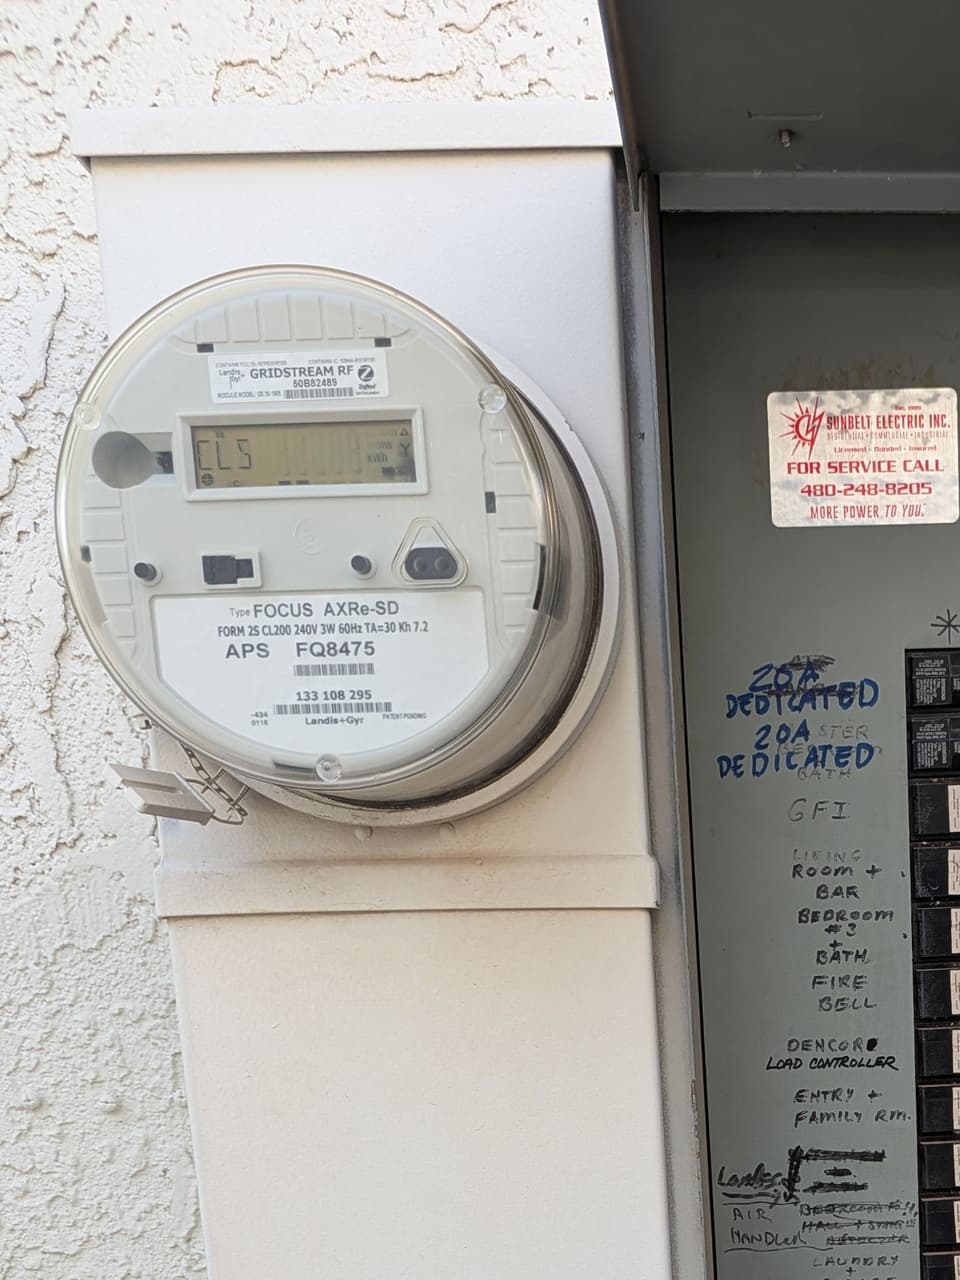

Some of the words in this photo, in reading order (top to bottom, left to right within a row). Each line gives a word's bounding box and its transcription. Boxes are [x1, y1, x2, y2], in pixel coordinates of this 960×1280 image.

[250, 366, 334, 379] GRIDSTREAM
[338, 365, 354, 376] RF
[293, 378, 338, 388] 50B82489
[827, 415, 871, 430] SUNBELT
[877, 414, 925, 429] ELECTRIC
[929, 414, 951, 429] INC.
[787, 462, 820, 474] FOR
[828, 461, 896, 474] SERVICE
[903, 460, 945, 472] CALL
[801, 482, 933, 497] 480-248-8205
[810, 506, 838, 519] MORE
[843, 505, 879, 518] POWER
[885, 505, 897, 517] TO
[230, 608, 250, 617] Type
[253, 603, 313, 618] FOCUS
[324, 601, 399, 616] AXRe-SD
[218, 625, 245, 637] FORM
[248, 625, 260, 636] 2S
[262, 624, 292, 636] CL200
[294, 624, 318, 635] 240V
[320, 623, 336, 634] 3W
[339, 623, 362, 634] 60Hz
[364, 622, 396, 633] TA=30
[399, 621, 411, 632] Kh
[414, 621, 429, 632] 7.2
[225, 643, 270, 659] APS
[296, 641, 376, 657] FQ8475
[295, 691, 318, 701] 133
[323, 690, 346, 701] 108
[349, 690, 372, 700] 295
[726, 679, 880, 719] DEDICATED
[305, 716, 364, 726] Landis+Gyr
[717, 743, 876, 779] DEDICATED
[788, 798, 850, 821] GFI
[816, 885, 860, 899] BAR
[798, 908, 895, 924] BEDROOM
[816, 949, 868, 964] BATH
[812, 975, 867, 990] FIRE
[818, 997, 877, 1012] BELL
[766, 1056, 802, 1071] LOAD
[809, 1055, 899, 1071] CONTROLLER
[793, 1089, 855, 1104] ENTRY
[794, 1110, 863, 1127] FAMILY
[733, 1208, 773, 1222] AIR
[813, 1255, 898, 1267] LAUNDRY
